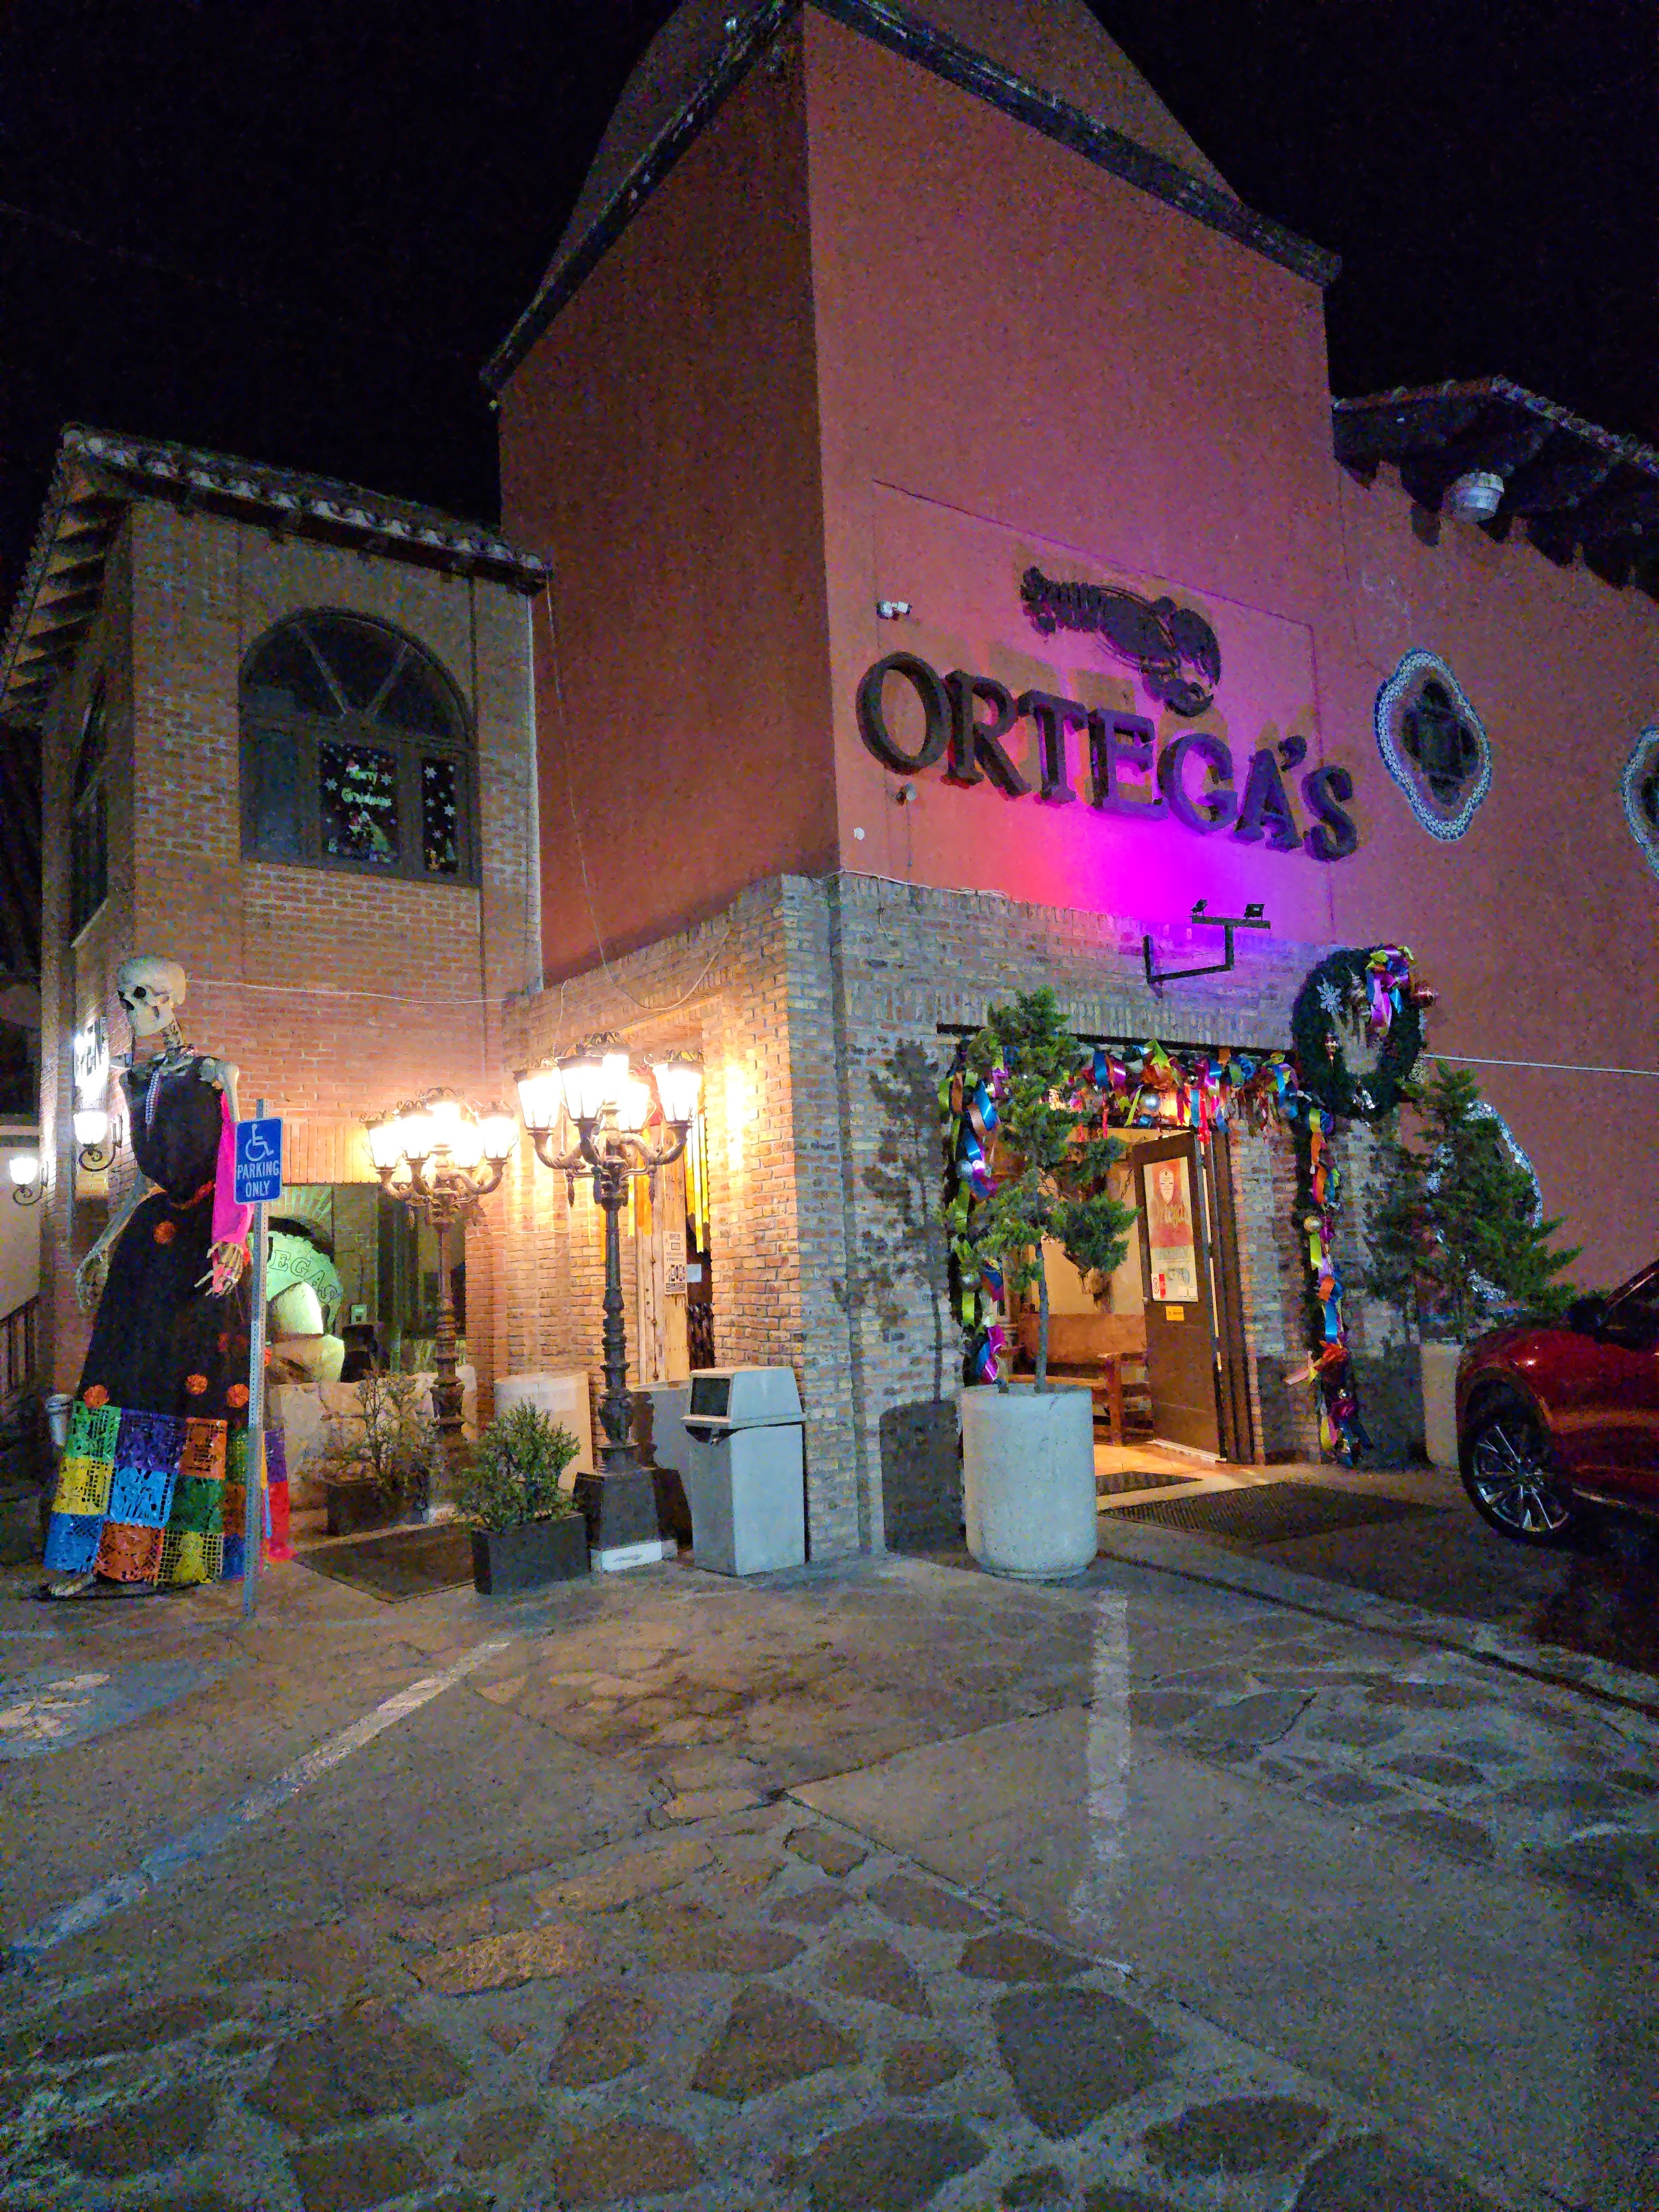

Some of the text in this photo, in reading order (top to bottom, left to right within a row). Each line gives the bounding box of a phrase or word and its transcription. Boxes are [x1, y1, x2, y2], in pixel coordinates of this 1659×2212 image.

[856, 652, 1358, 862] ORTEGA'S
[237, 1160, 279, 1180] PARKING
[245, 1180, 271, 1198] ONLY
